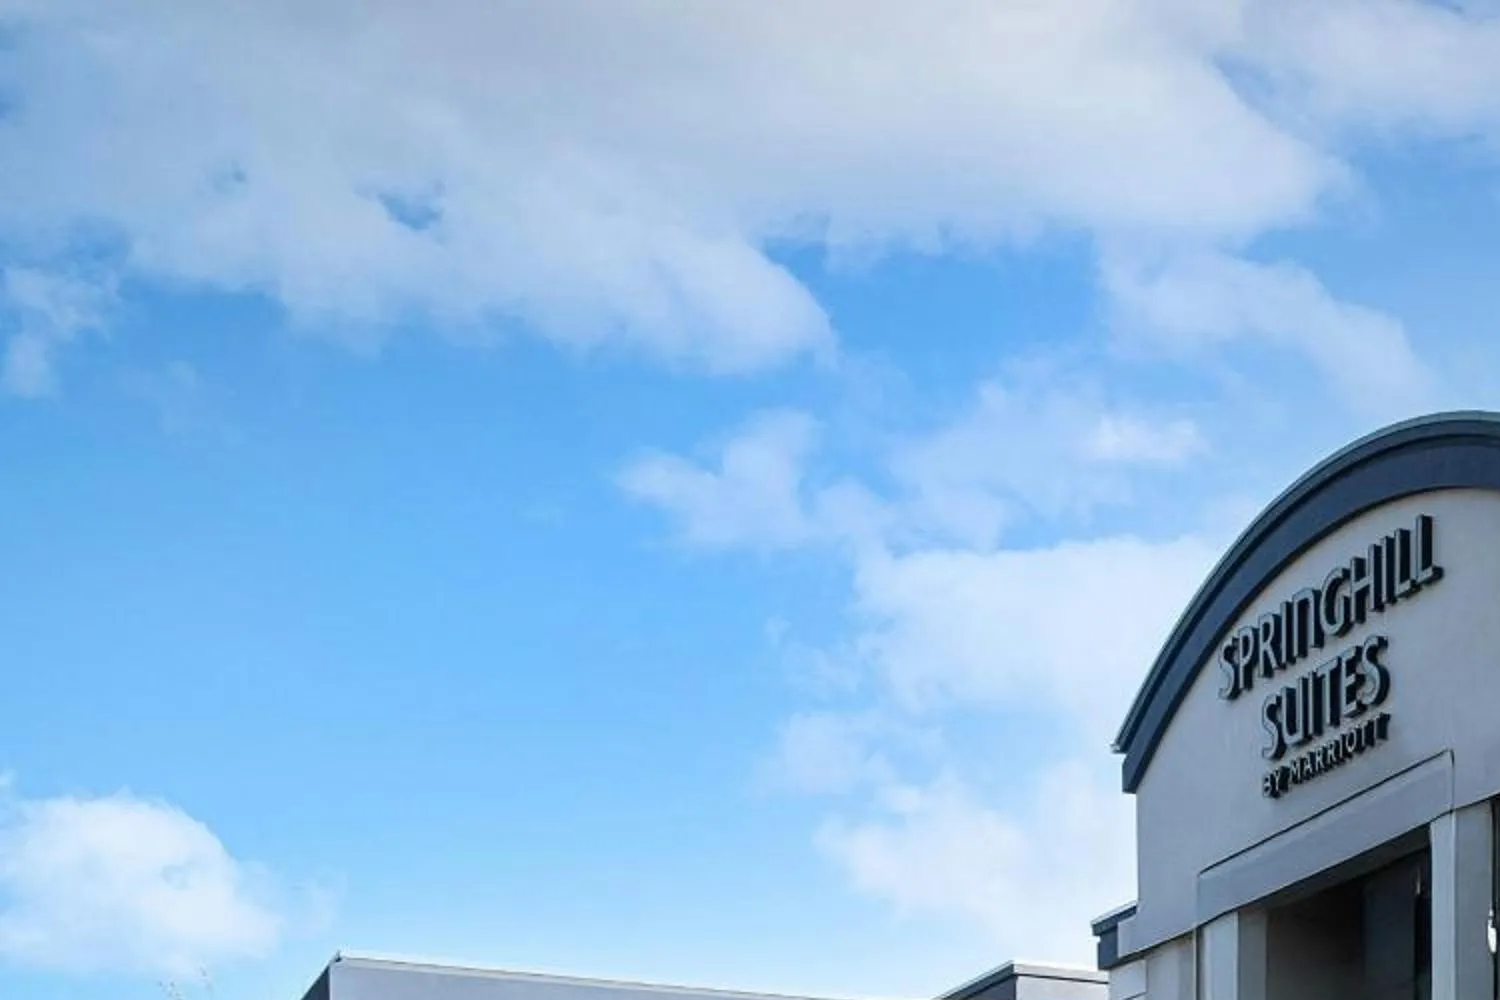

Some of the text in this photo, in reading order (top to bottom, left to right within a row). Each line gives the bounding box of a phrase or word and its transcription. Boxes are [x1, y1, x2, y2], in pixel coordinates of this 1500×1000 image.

[1218, 514, 1443, 700] SPRINGHILL
[1261, 635, 1391, 760] SUITES
[1262, 712, 1391, 798] BY MARRIOTT
